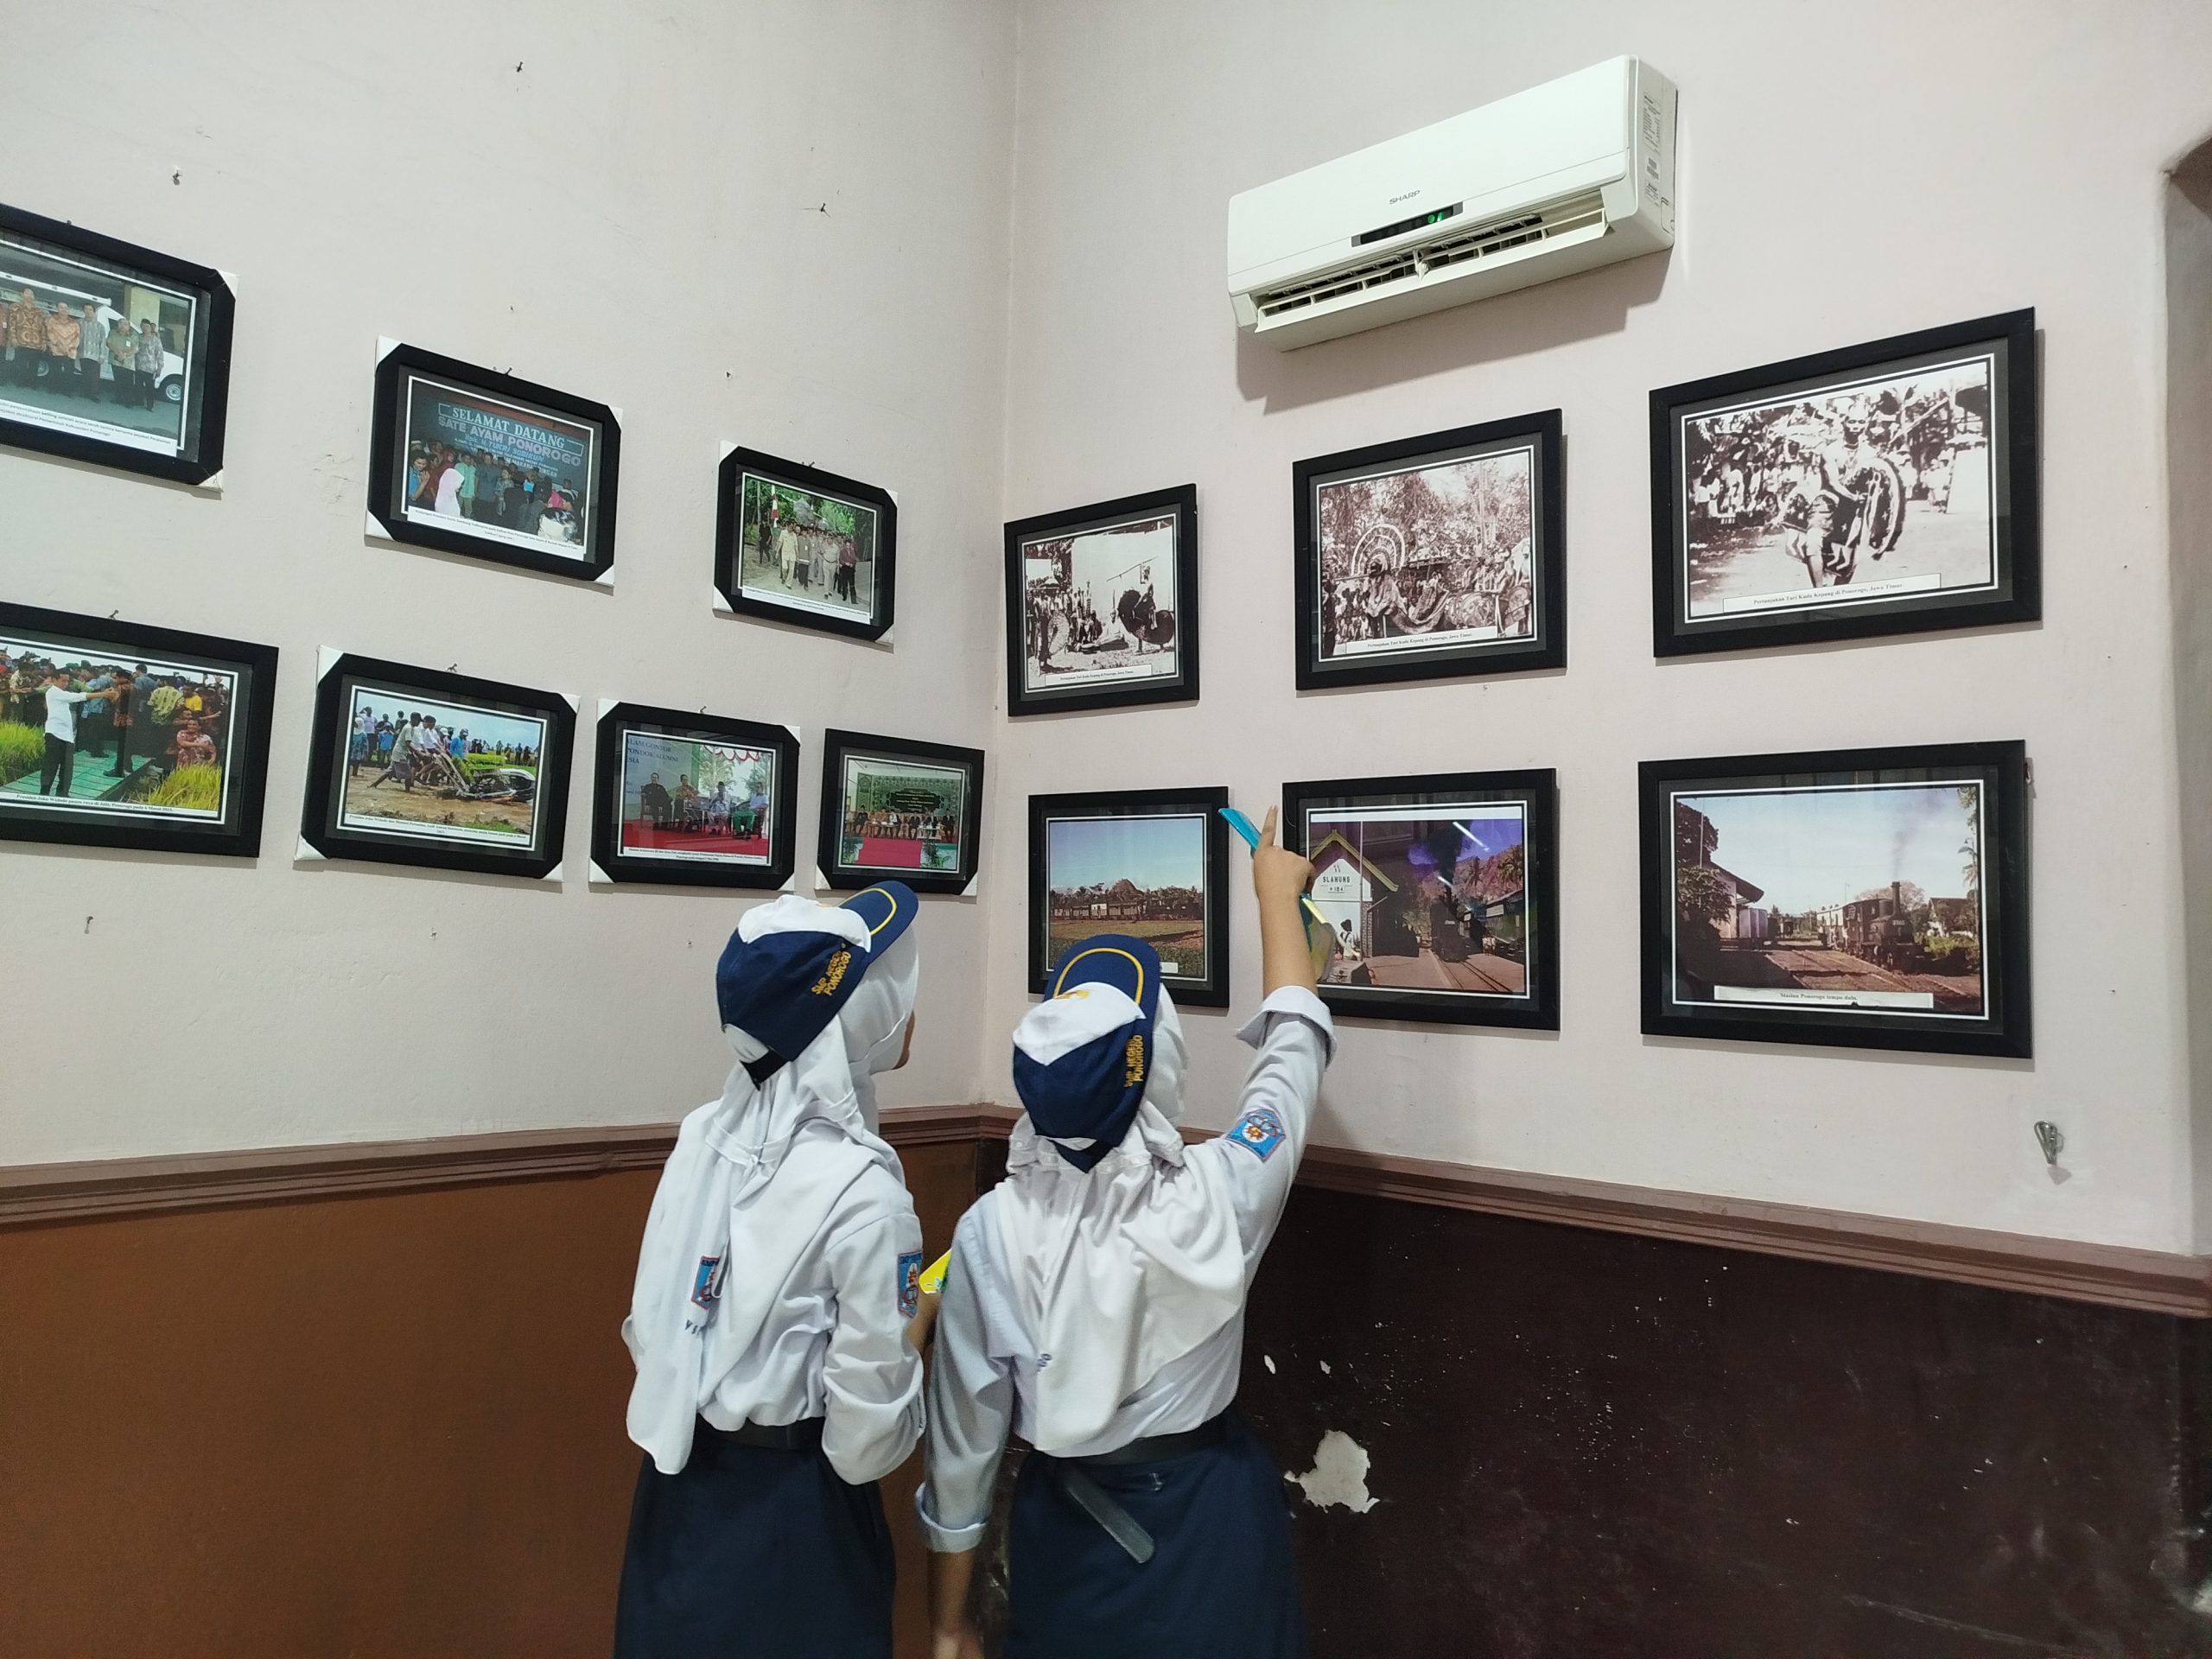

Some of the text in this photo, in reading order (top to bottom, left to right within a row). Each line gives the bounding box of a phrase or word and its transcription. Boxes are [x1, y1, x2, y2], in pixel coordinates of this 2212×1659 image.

[1389, 189, 1421, 205] SHARP
[438, 416, 467, 433] SATE
[470, 425, 504, 444] AYAM
[507, 435, 582, 467] PONOROGO
[452, 407, 565, 448] SELAMAT DATANG
[823, 950, 852, 996] PONOROGO
